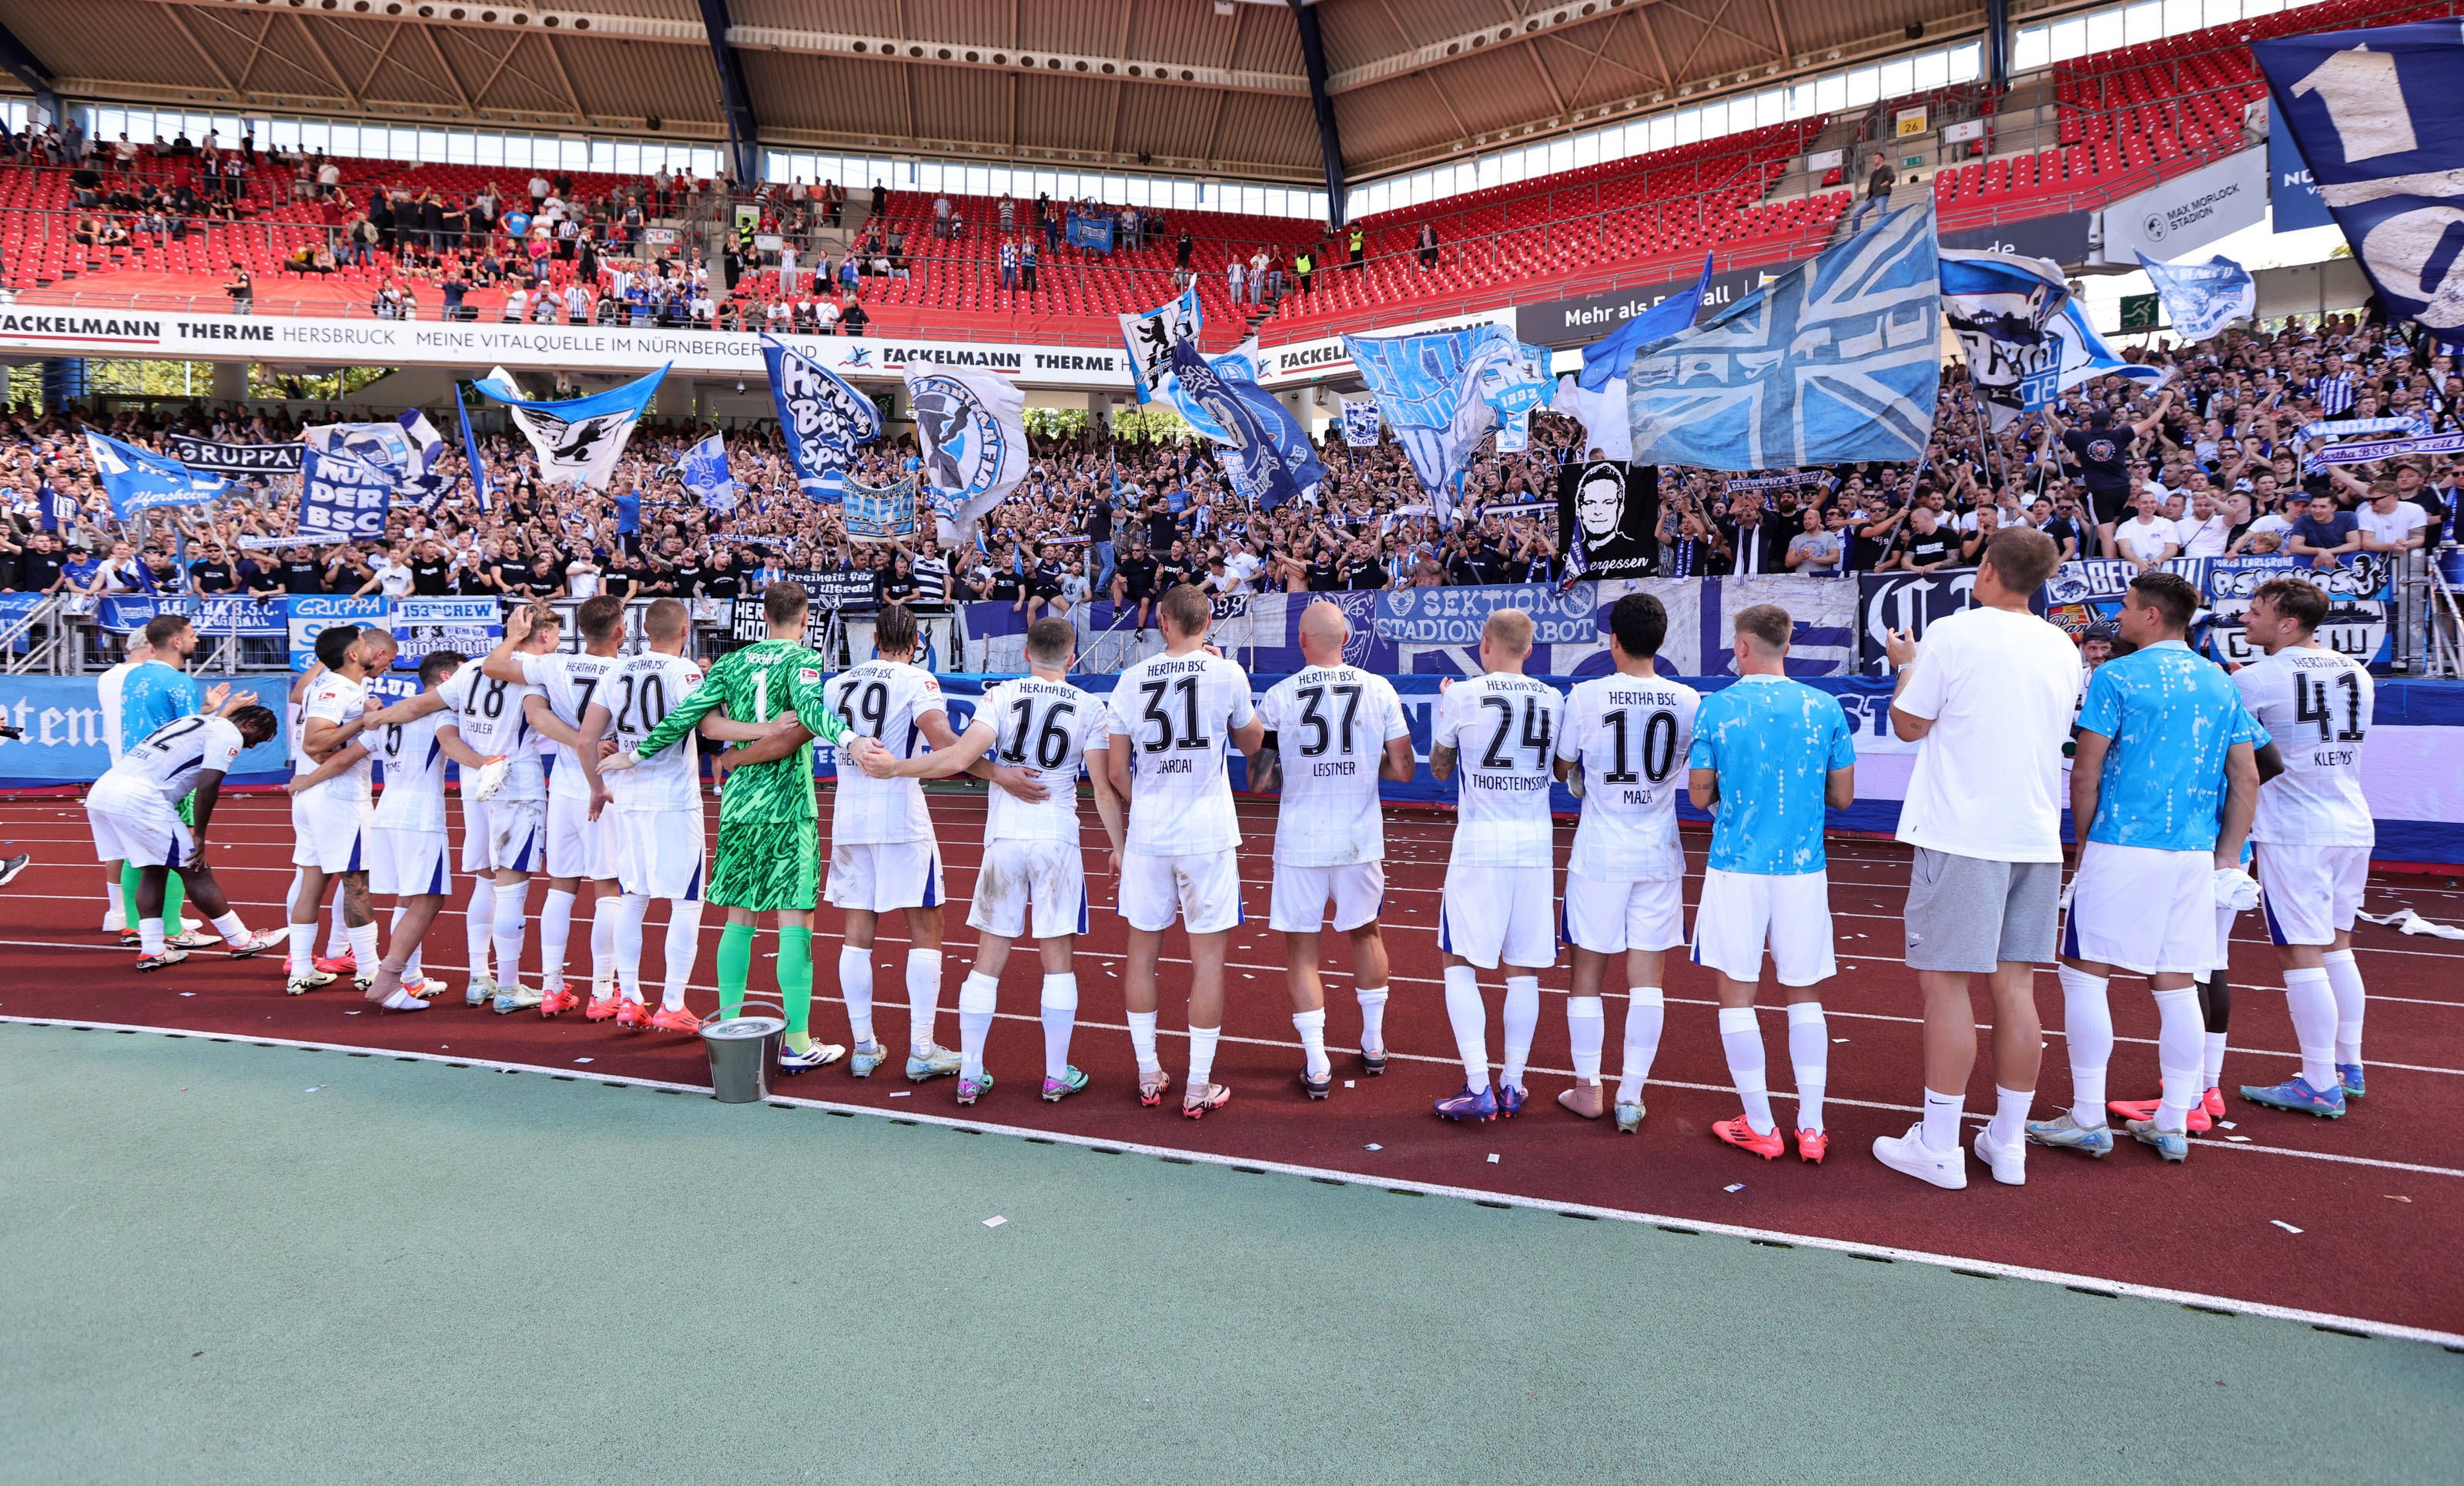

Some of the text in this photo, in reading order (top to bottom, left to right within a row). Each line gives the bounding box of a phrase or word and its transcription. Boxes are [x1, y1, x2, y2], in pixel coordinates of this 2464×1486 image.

[1905, 122, 1919, 133] 26
[2167, 183, 2241, 220] MAX MORLOCK
[2171, 205, 2214, 231] STADION
[1565, 307, 1614, 326] Mehr
[1619, 301, 1649, 320] als
[178, 323, 274, 341] THERME
[283, 326, 396, 346] HERSBRUCK
[417, 332, 474, 347] MEINE
[480, 333, 605, 353] VITALQUELLE
[611, 338, 631, 352] IM
[638, 336, 762, 356] NÜRNBERGER
[884, 348, 1021, 367] FACKELMANN
[1035, 354, 1114, 371] THERME
[179, 441, 302, 467] GRUPPA!
[2359, 446, 2390, 457] BSC
[1732, 470, 1821, 492] HERTHA BSC
[310, 480, 383, 508] DER
[307, 505, 382, 531] BSC
[1588, 556, 1649, 576] ergessen
[2241, 557, 2294, 567] KARLSRUHE
[787, 571, 874, 582] Freiheit für
[820, 582, 874, 594] Ultras!
[296, 597, 381, 616] GRUPPA
[444, 604, 492, 617] CREW
[1423, 587, 1559, 617] SEKTION
[1377, 618, 1595, 642] STADIONRBOT
[848, 668, 895, 679] HERTHA BSC
[1147, 660, 1207, 677] HERTHA BSC
[2292, 657, 2339, 668] HERTHA
[1299, 670, 1358, 685] HERTHA BSC
[1487, 681, 1548, 694] HERTHA BSC
[464, 665, 510, 720] 18
[572, 676, 600, 725] 7
[617, 672, 667, 735] 20
[751, 668, 770, 724] 1
[1060, 688, 1078, 701] BSC
[1609, 691, 1678, 707] HERTHA BSC
[837, 680, 889, 742] 39
[1140, 675, 1210, 754] 31
[2293, 671, 2366, 744] 41
[1296, 684, 1364, 758] 37
[1480, 694, 1553, 771] 24
[1000, 697, 1077, 771] 16
[1602, 708, 1679, 785] 10
[1313, 761, 1356, 777] LEISTNER
[1472, 774, 1551, 791] THORSTEINSSON
[1623, 790, 1652, 805] MAZA
